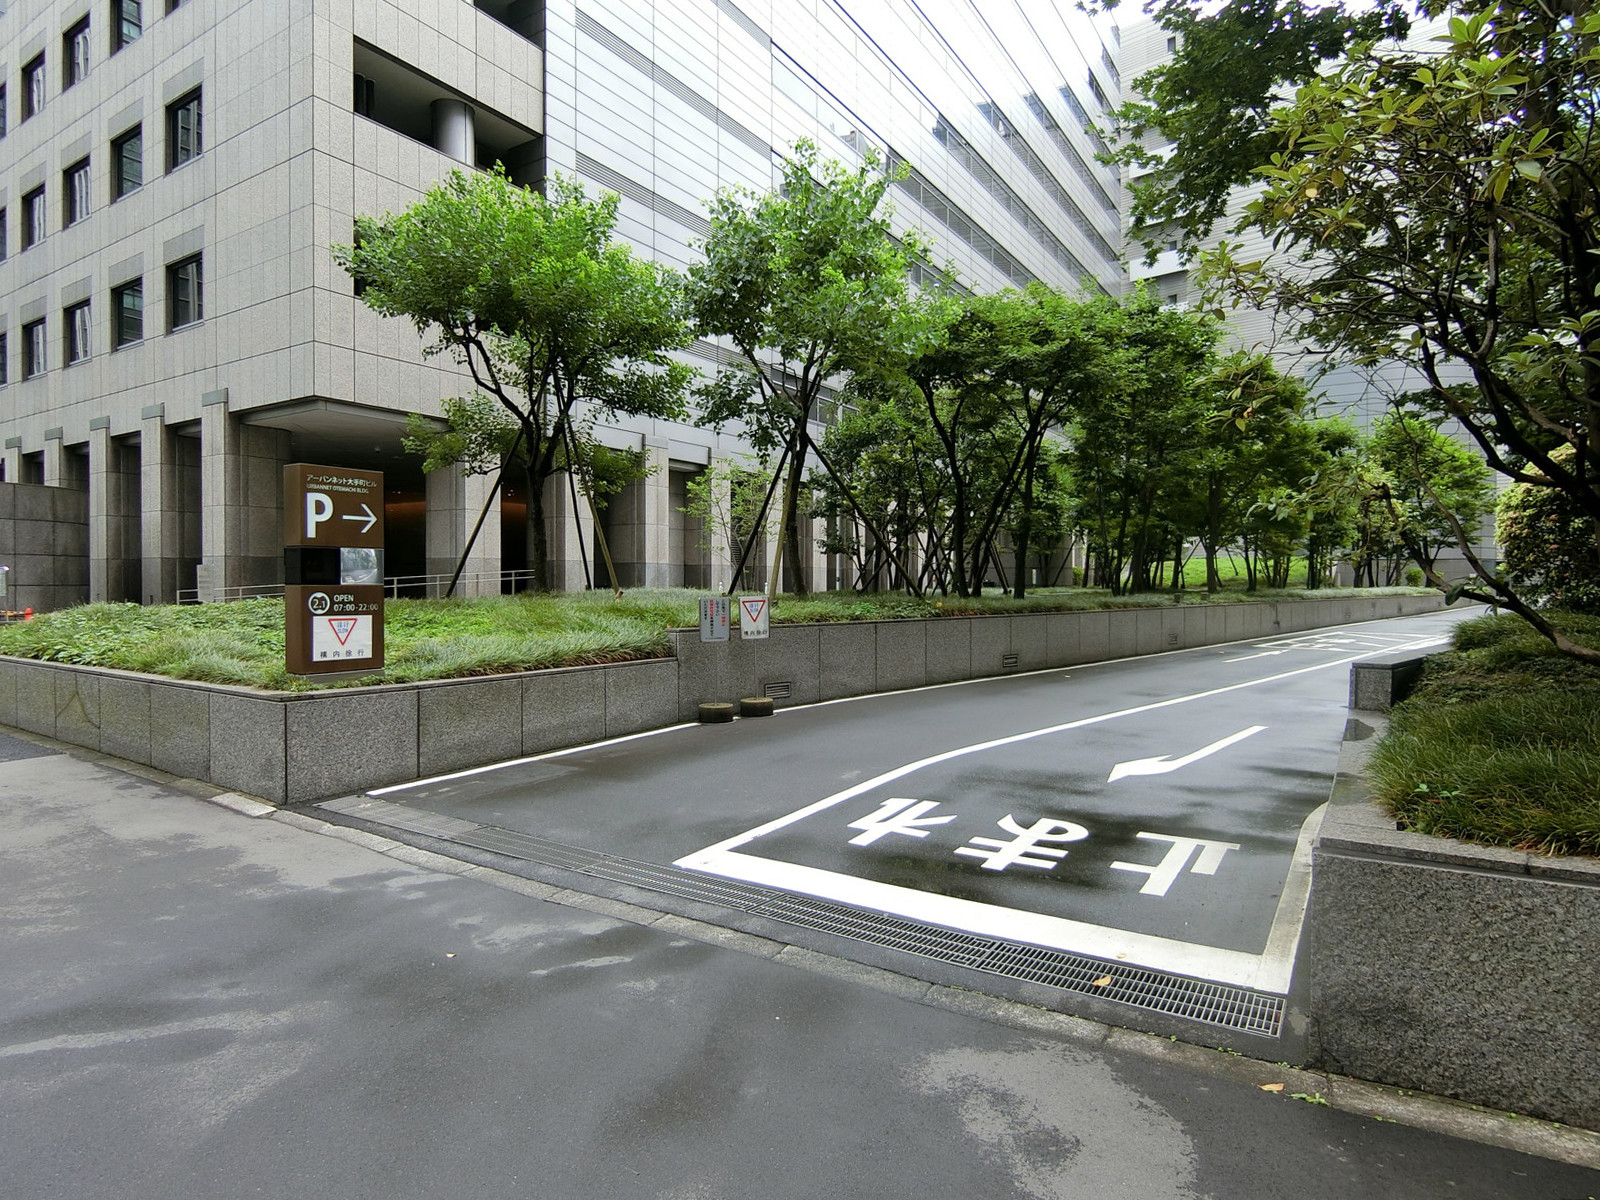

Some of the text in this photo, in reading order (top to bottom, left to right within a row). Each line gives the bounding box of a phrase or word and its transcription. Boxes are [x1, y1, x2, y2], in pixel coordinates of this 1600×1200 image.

[305, 492, 334, 539] P
[312, 598, 326, 610] 2.1
[333, 594, 354, 603] OPEN
